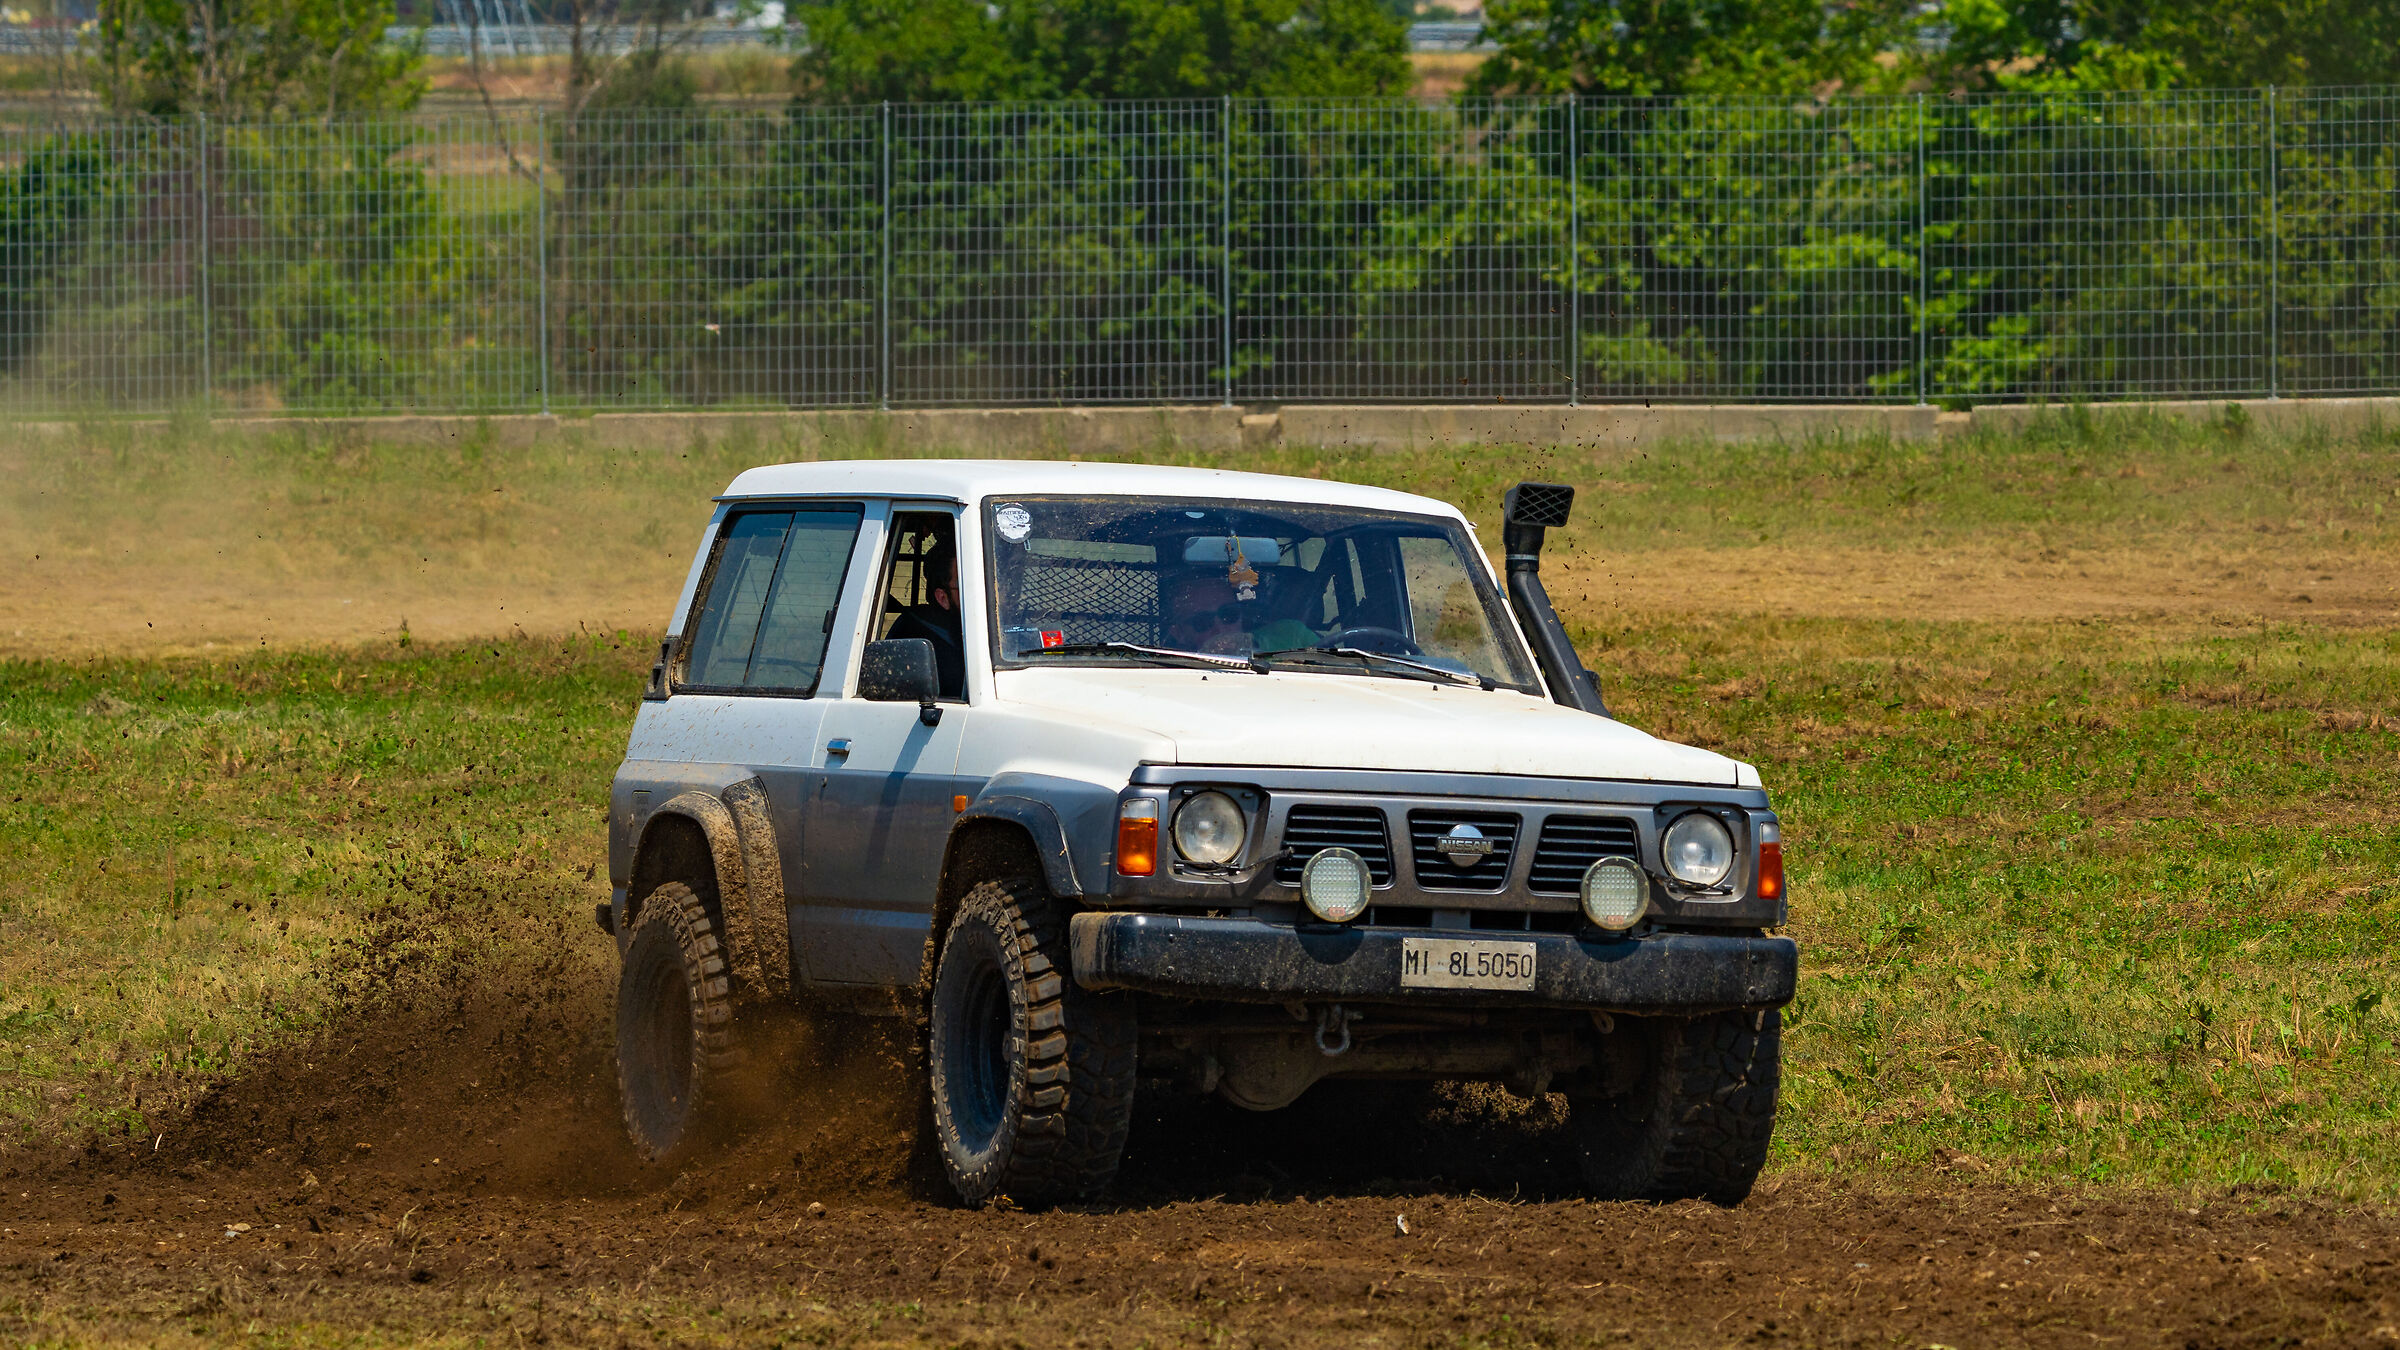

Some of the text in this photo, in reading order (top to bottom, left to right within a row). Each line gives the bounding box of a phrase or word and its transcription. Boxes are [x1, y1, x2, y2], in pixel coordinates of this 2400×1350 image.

[1440, 838, 1493, 854] NISSAN
[1405, 950, 1533, 978] MI 8L5050
